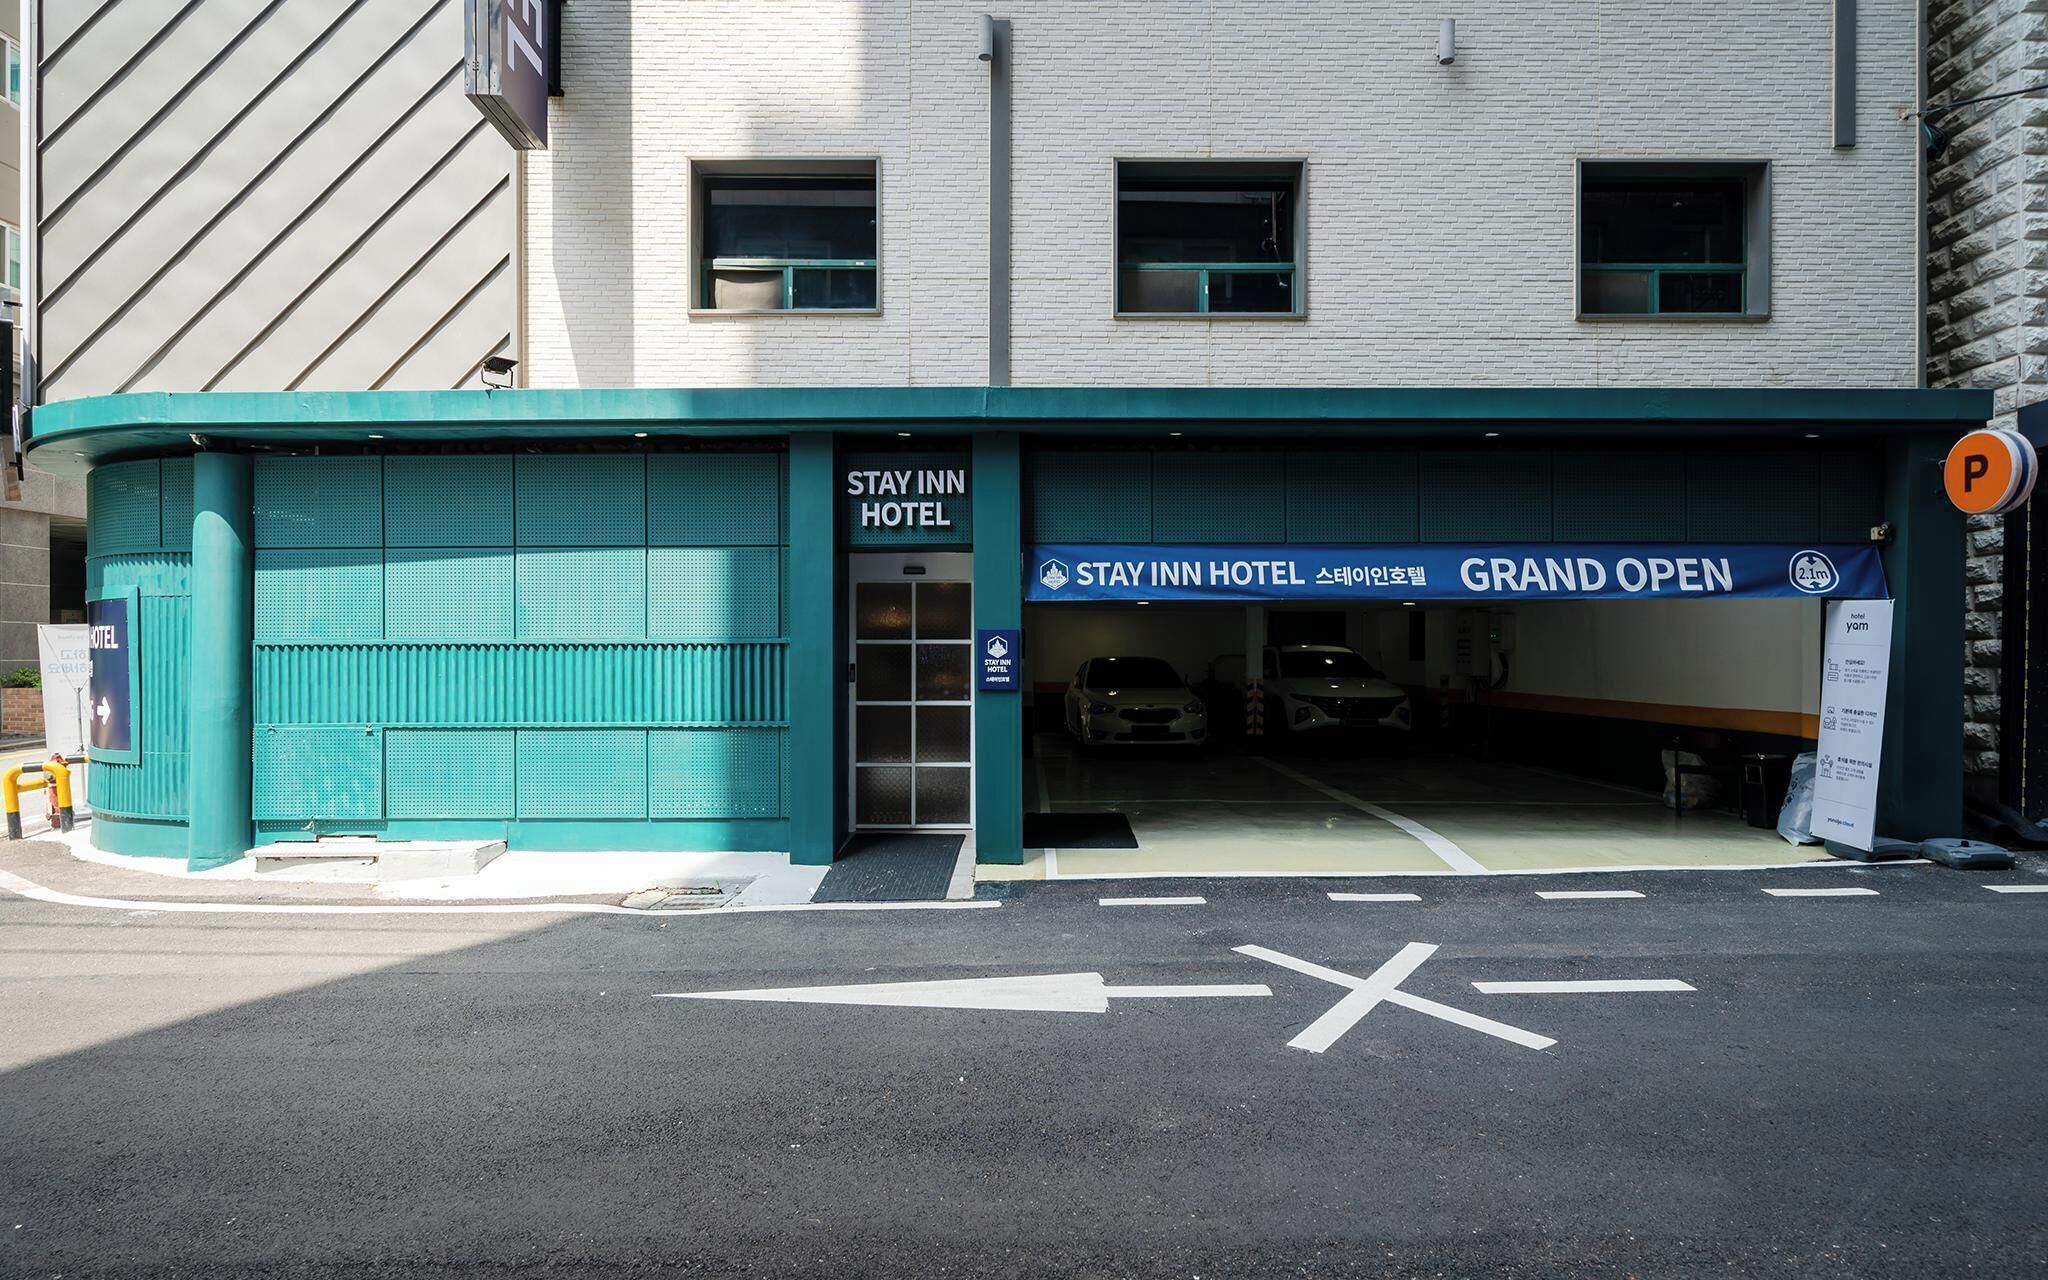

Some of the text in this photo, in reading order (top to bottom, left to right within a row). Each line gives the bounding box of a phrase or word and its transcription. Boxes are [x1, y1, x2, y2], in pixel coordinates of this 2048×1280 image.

[847, 470, 965, 496] STAY INN
[1964, 454, 1988, 492] P
[861, 502, 951, 527] HOTEL
[1076, 560, 1427, 587] STAY INN HOTEL 스테이인호텔
[1460, 557, 1733, 592] GRAND OPEN
[1799, 567, 1829, 580] 2.1m
[1846, 621, 1869, 634] yam
